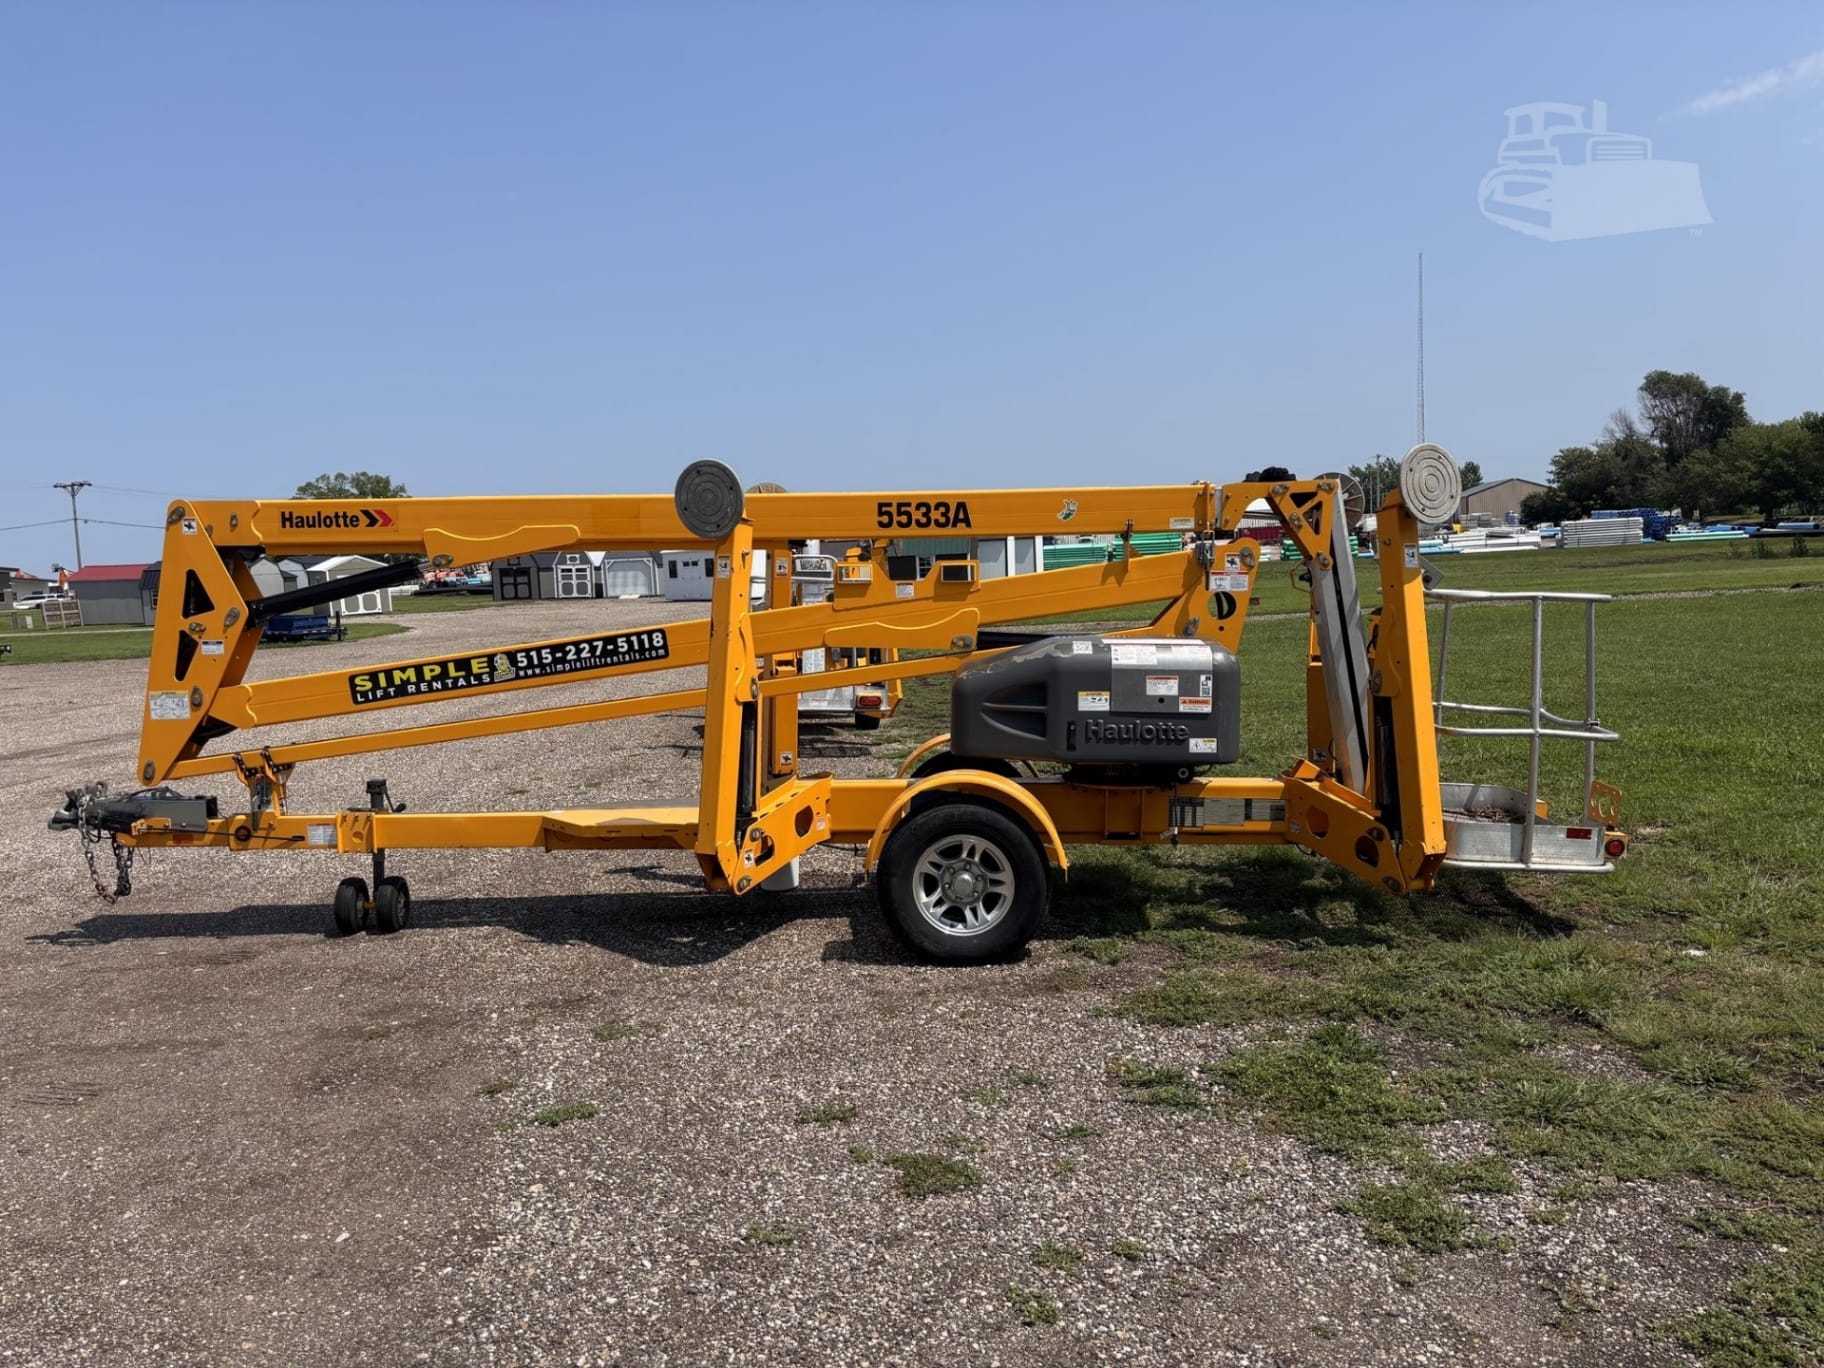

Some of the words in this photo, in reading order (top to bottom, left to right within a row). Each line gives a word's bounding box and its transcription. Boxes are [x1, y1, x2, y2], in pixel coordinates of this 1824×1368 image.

[280, 510, 361, 529] Haulotte
[876, 501, 972, 529] 5533A
[516, 631, 664, 667] 515-227-5118
[518, 649, 666, 677] www.simpleliftrentals.com
[353, 656, 490, 692] SIMPLE
[356, 687, 396, 702] LIFT
[407, 673, 491, 694] RENTALS
[1084, 719, 1191, 745] Haulotte
